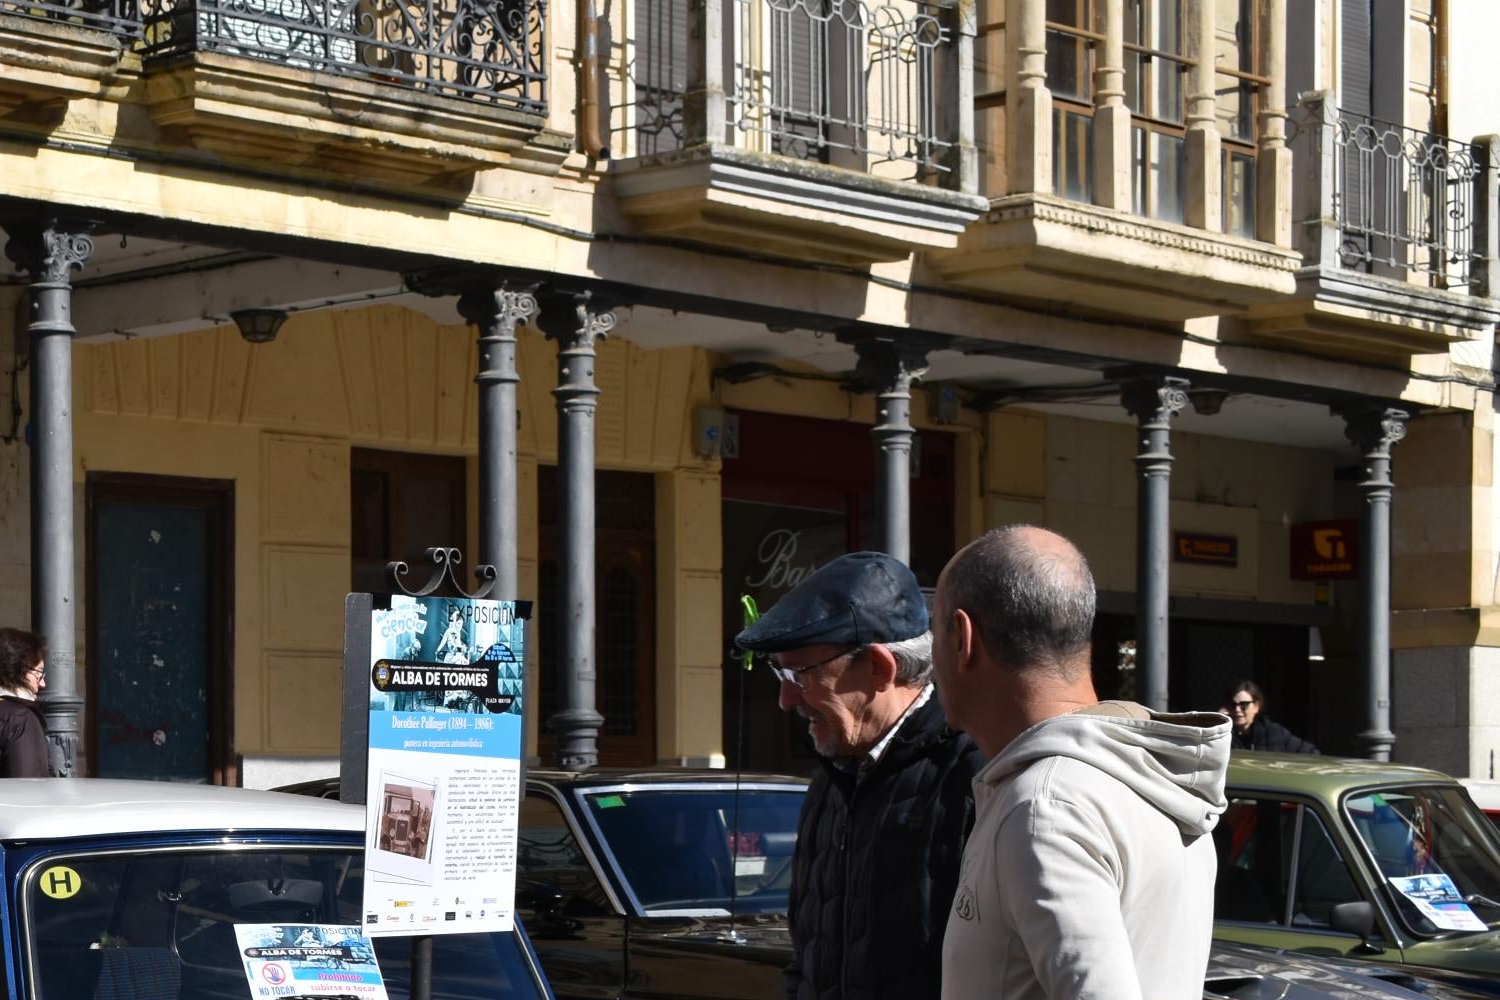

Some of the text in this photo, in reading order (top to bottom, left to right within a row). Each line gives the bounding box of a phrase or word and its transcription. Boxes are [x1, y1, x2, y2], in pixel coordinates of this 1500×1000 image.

[446, 602, 516, 625] EXPOSICIÓN
[381, 612, 425, 638] ciencia
[392, 671, 488, 687] ALBA DE TORMES
[48, 870, 73, 895] H
[318, 972, 362, 982] Prohibido
[259, 986, 296, 996] NO TOCAR
[310, 984, 343, 992] subirse
